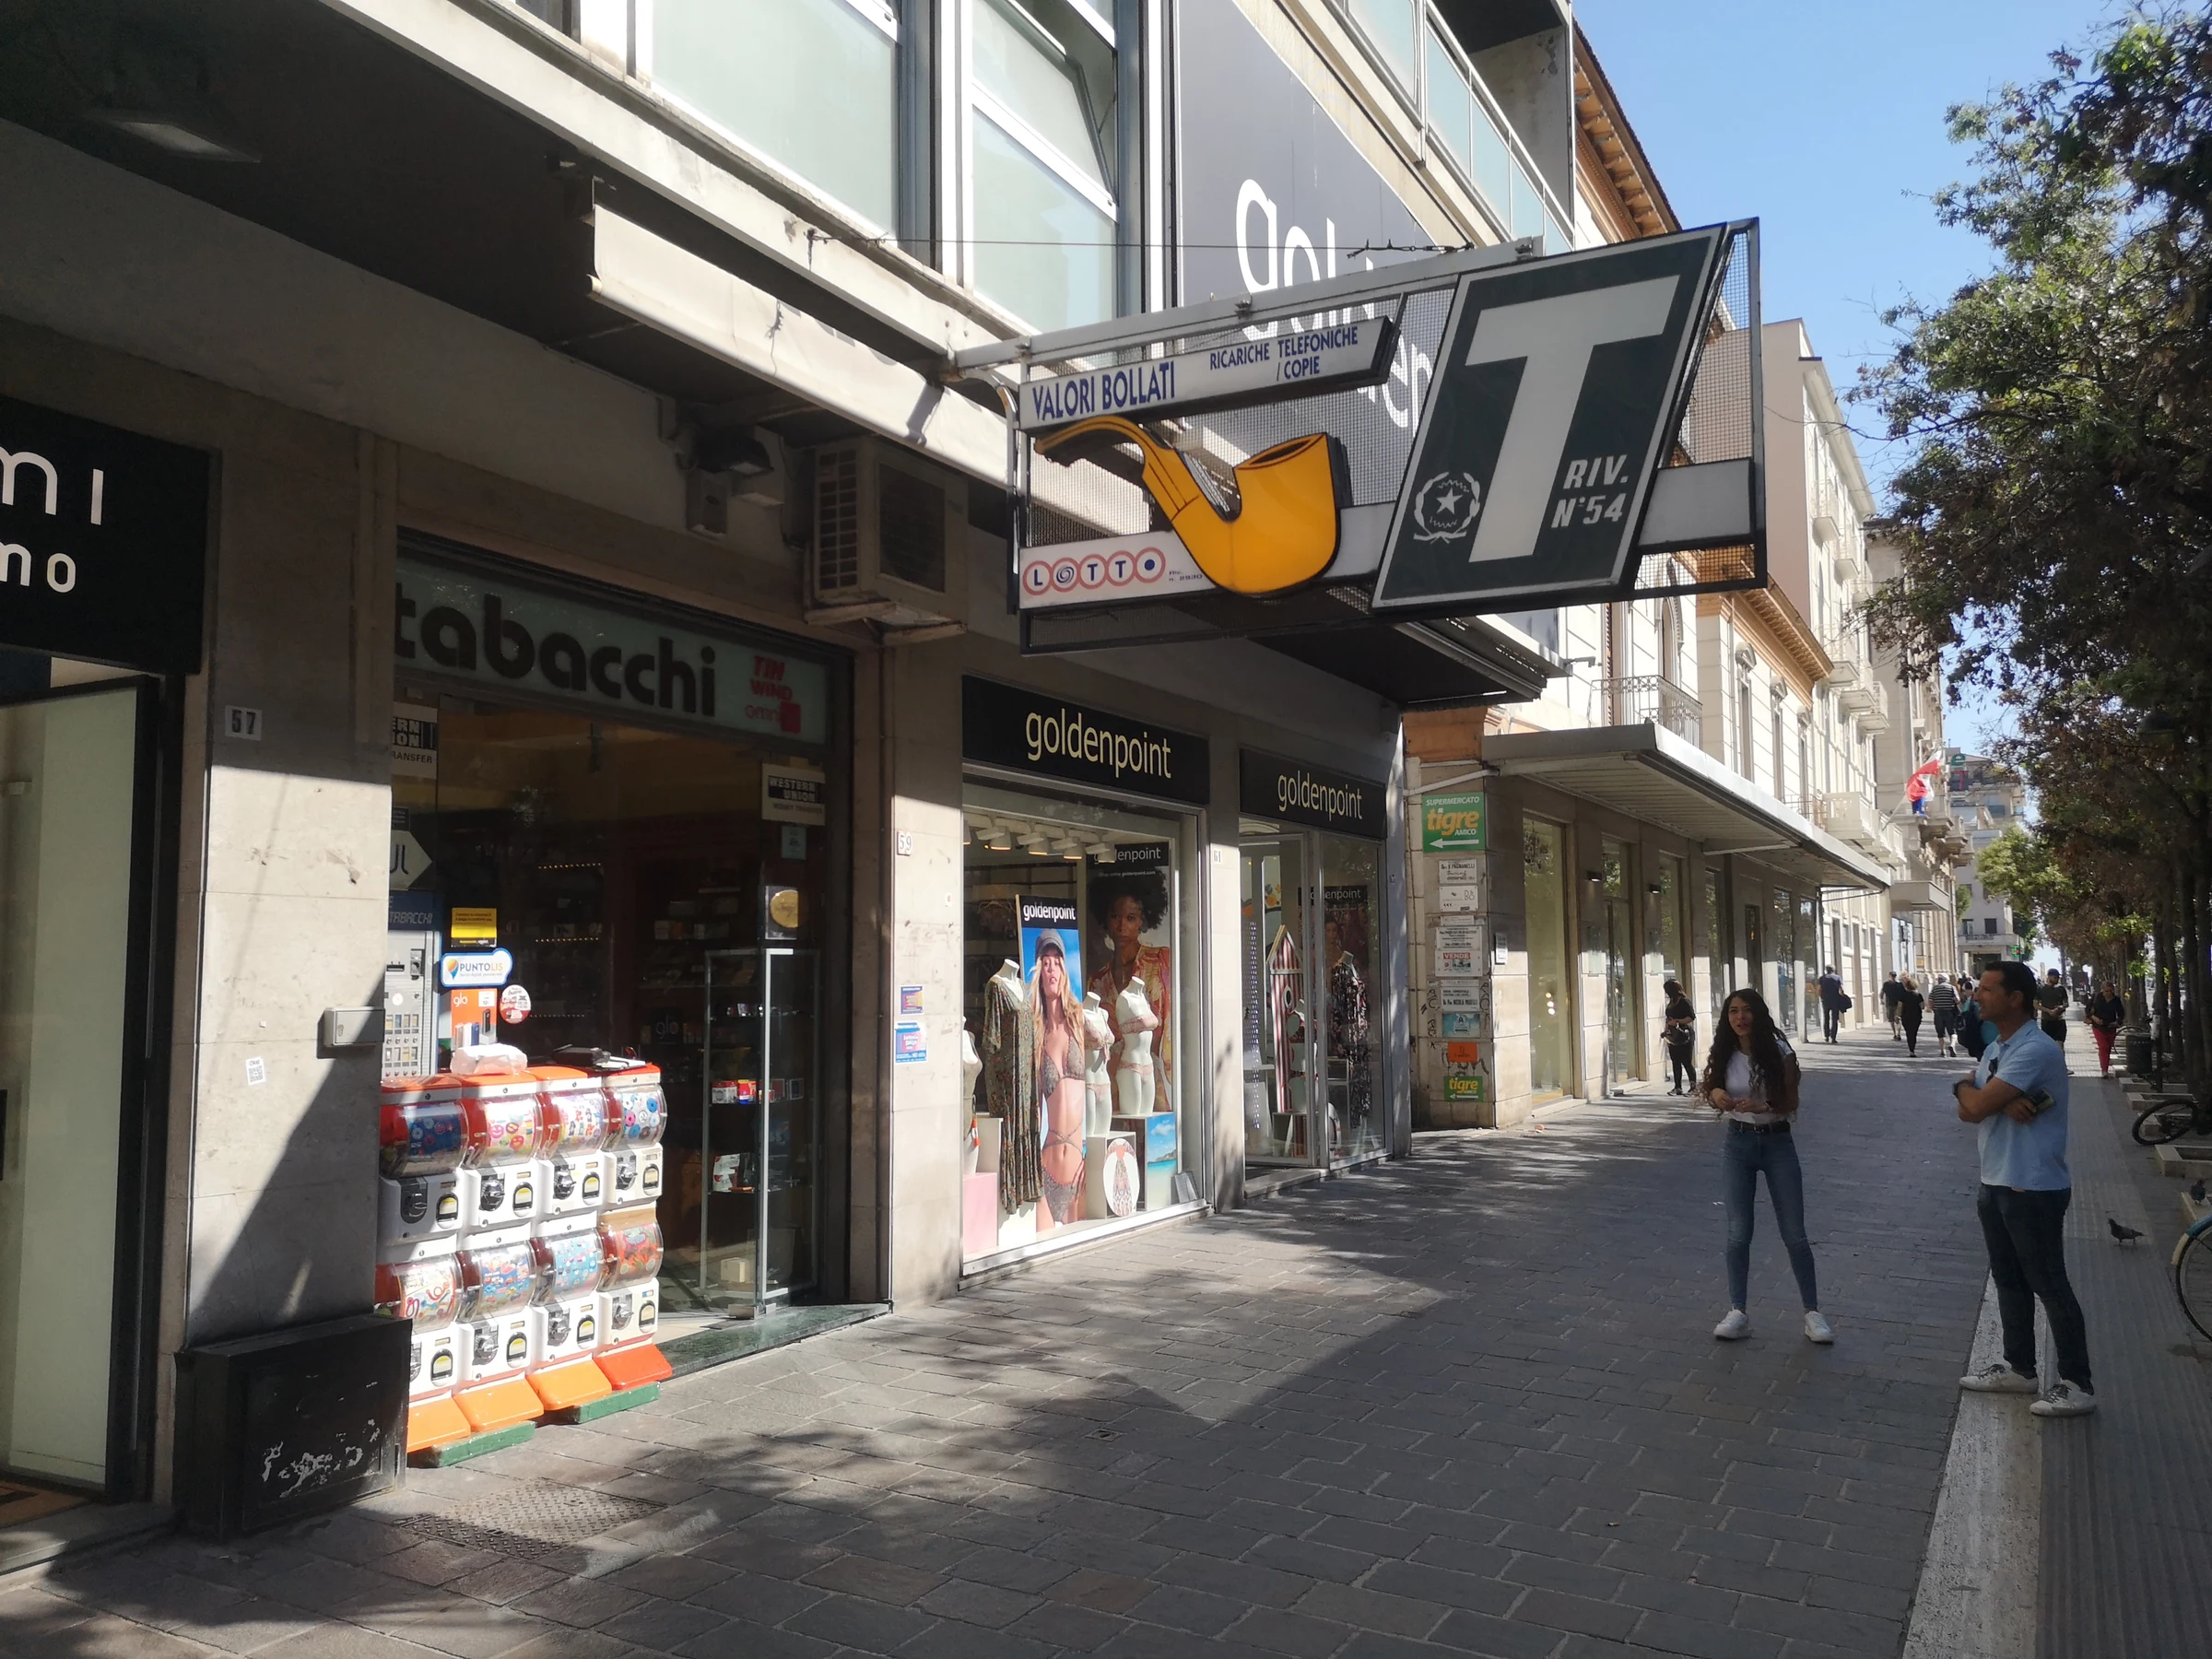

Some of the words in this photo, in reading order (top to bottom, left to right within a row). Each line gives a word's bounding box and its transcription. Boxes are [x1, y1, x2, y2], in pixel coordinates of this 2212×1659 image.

[1209, 342, 1270, 371] RICARICHE
[1277, 326, 1359, 359] TELEFONICHE
[1033, 379, 1096, 421] VALORI
[1102, 361, 1176, 412] BOLLATI
[1465, 274, 1680, 563] T
[1563, 454, 1630, 490] RIV.
[395, 582, 716, 718] tabacchi
[1026, 708, 1172, 780] goldenpoint
[770, 777, 816, 793] WESTERN
[783, 789, 816, 803] UNION
[1278, 770, 1363, 821] goldenpoint
[1426, 796, 1479, 806] SUPERMERCATO
[1427, 807, 1480, 837] tigre
[1454, 828, 1477, 836] AMICO
[900, 834, 912, 852] 59
[1023, 901, 1077, 923] goldenpoint
[453, 993, 468, 1007] glo
[1449, 1077, 1478, 1094] tigre
